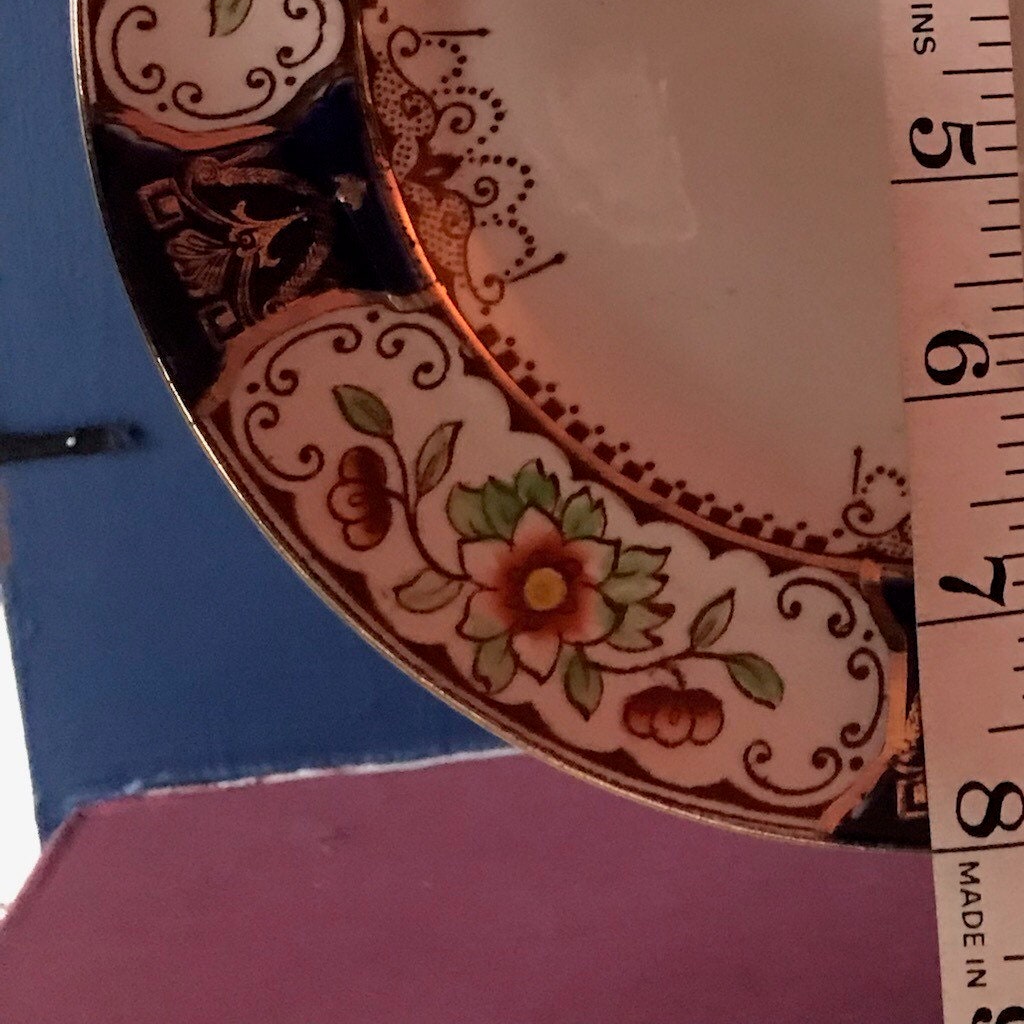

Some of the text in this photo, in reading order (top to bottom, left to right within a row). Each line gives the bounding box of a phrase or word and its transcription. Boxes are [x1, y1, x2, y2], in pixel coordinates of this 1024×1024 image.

[911, 3, 936, 55] INS
[909, 117, 977, 169] 5
[924, 329, 990, 385] 6
[938, 555, 1007, 607] 7
[958, 861, 988, 988] MADE IN
